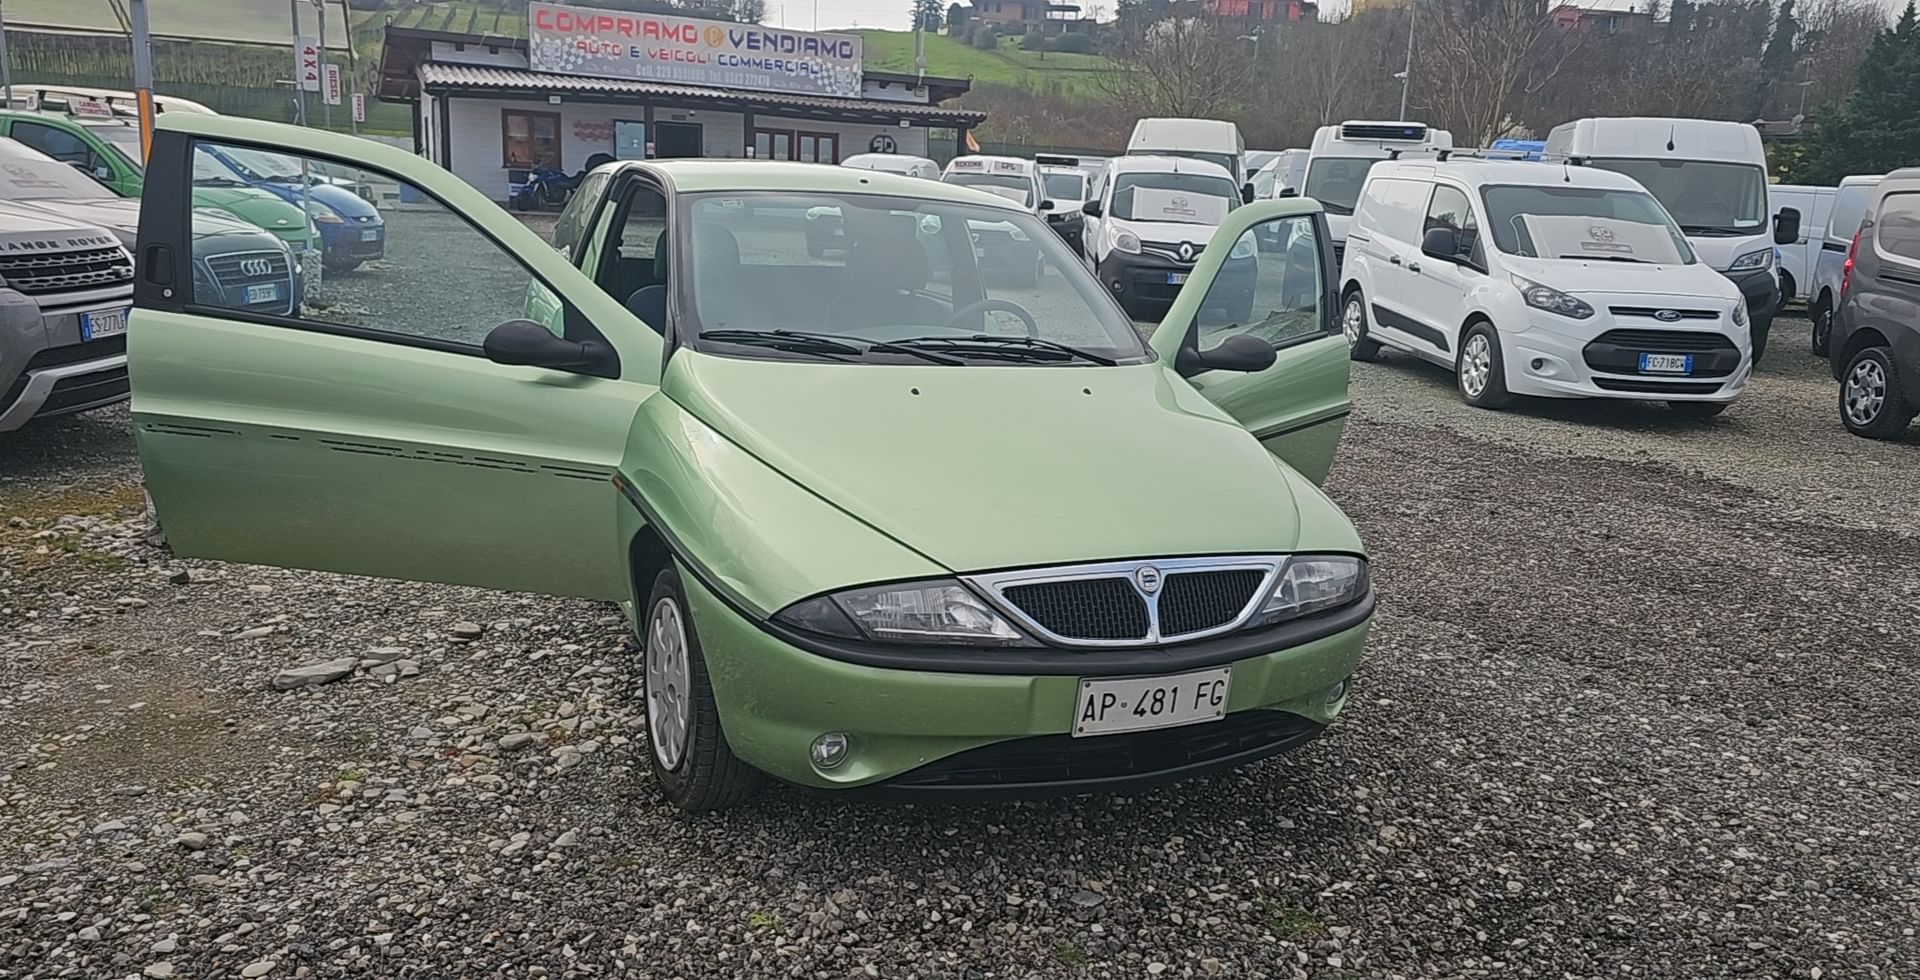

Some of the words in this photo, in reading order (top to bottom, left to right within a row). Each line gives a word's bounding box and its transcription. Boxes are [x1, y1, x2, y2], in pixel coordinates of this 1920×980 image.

[536, 9, 698, 44] COMPRIAMO
[728, 29, 853, 60] VENDIAMO
[576, 41, 622, 57] AUTO
[630, 46, 640, 58] E
[648, 47, 711, 65] VEICOLI
[717, 54, 823, 75] COMMERCIALI
[1133, 688, 1178, 717] 481
[1194, 680, 1225, 710] FG
